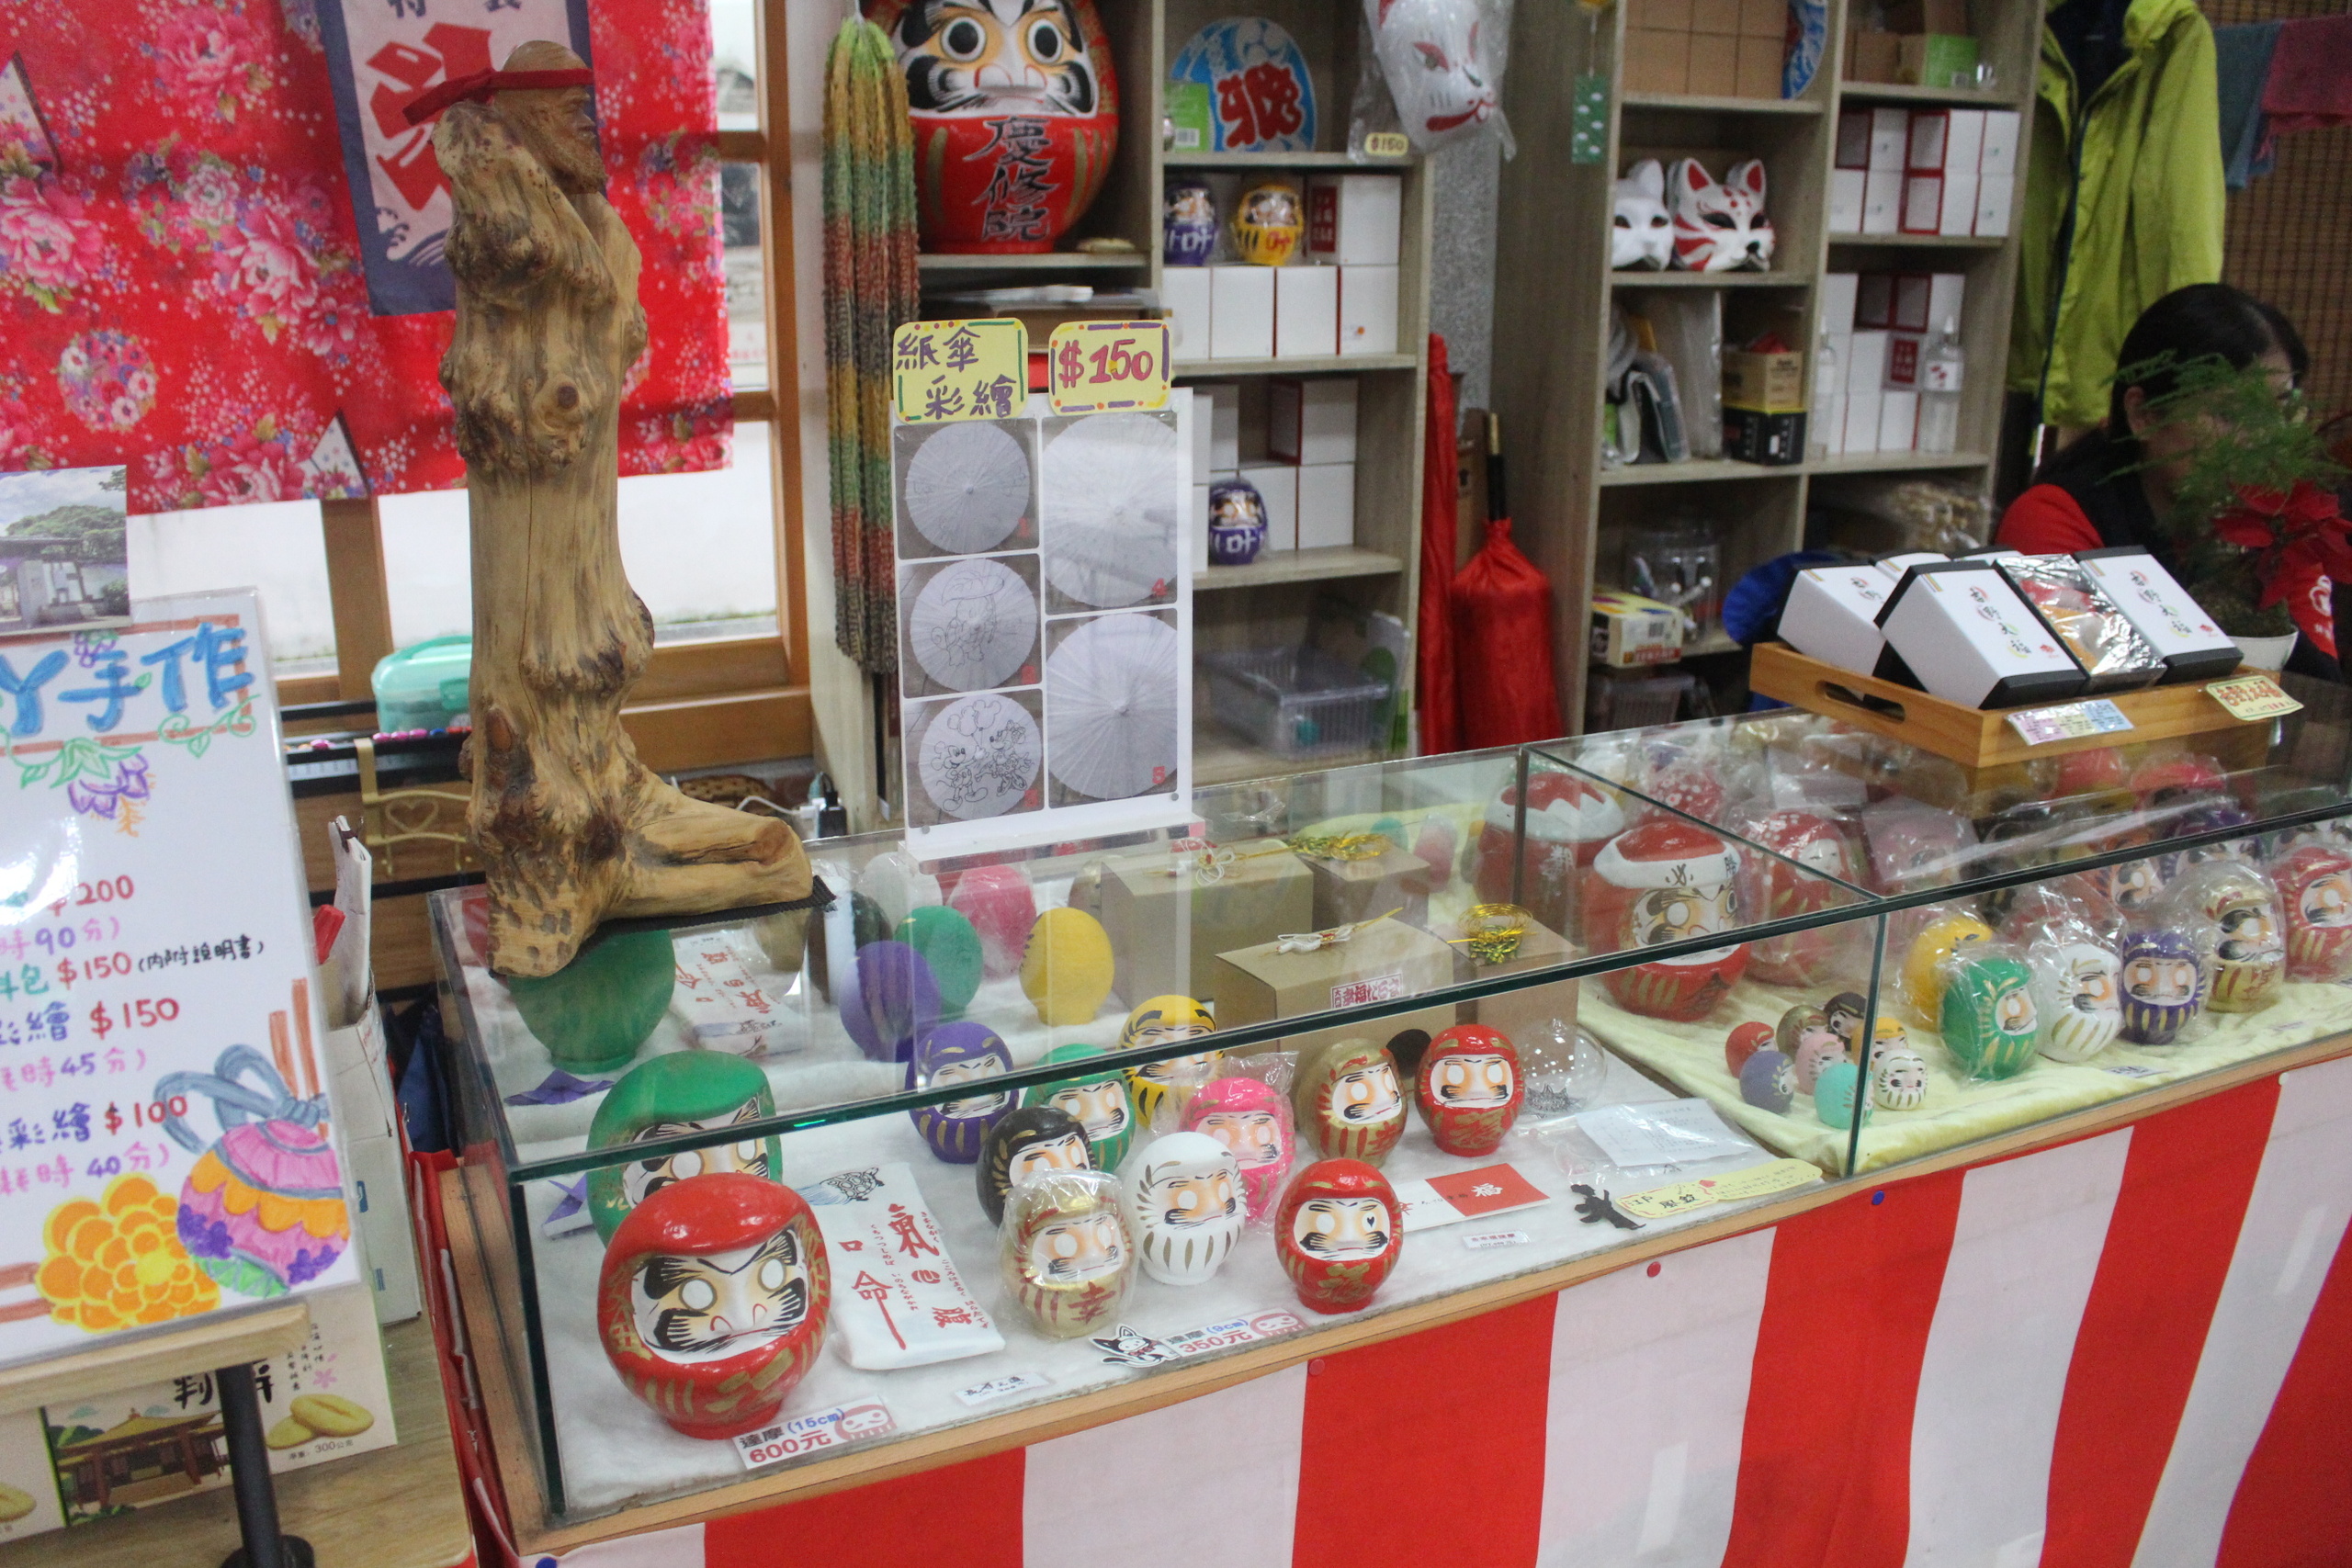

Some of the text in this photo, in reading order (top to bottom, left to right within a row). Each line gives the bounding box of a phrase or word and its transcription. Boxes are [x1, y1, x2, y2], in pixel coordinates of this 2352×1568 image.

[1371, 137, 1406, 153] $150
[963, 116, 1060, 243] 慶修院
[896, 327, 981, 371] 紙傘
[1059, 338, 1153, 388] $150
[924, 374, 1016, 418] 彩繪
[1152, 578, 1167, 595] 4
[1152, 765, 1166, 784] 5
[1666, 863, 1694, 886] 必
[57, 952, 132, 990] $150
[89, 998, 180, 1040] $150
[105, 1095, 188, 1135] $100
[1471, 1182, 1504, 1197] 福
[1068, 1280, 1117, 1325] 幸
[1179, 1330, 1253, 1353] 350元
[740, 1407, 846, 1450] 達摩 (15cm)
[749, 1429, 832, 1463] 600元
